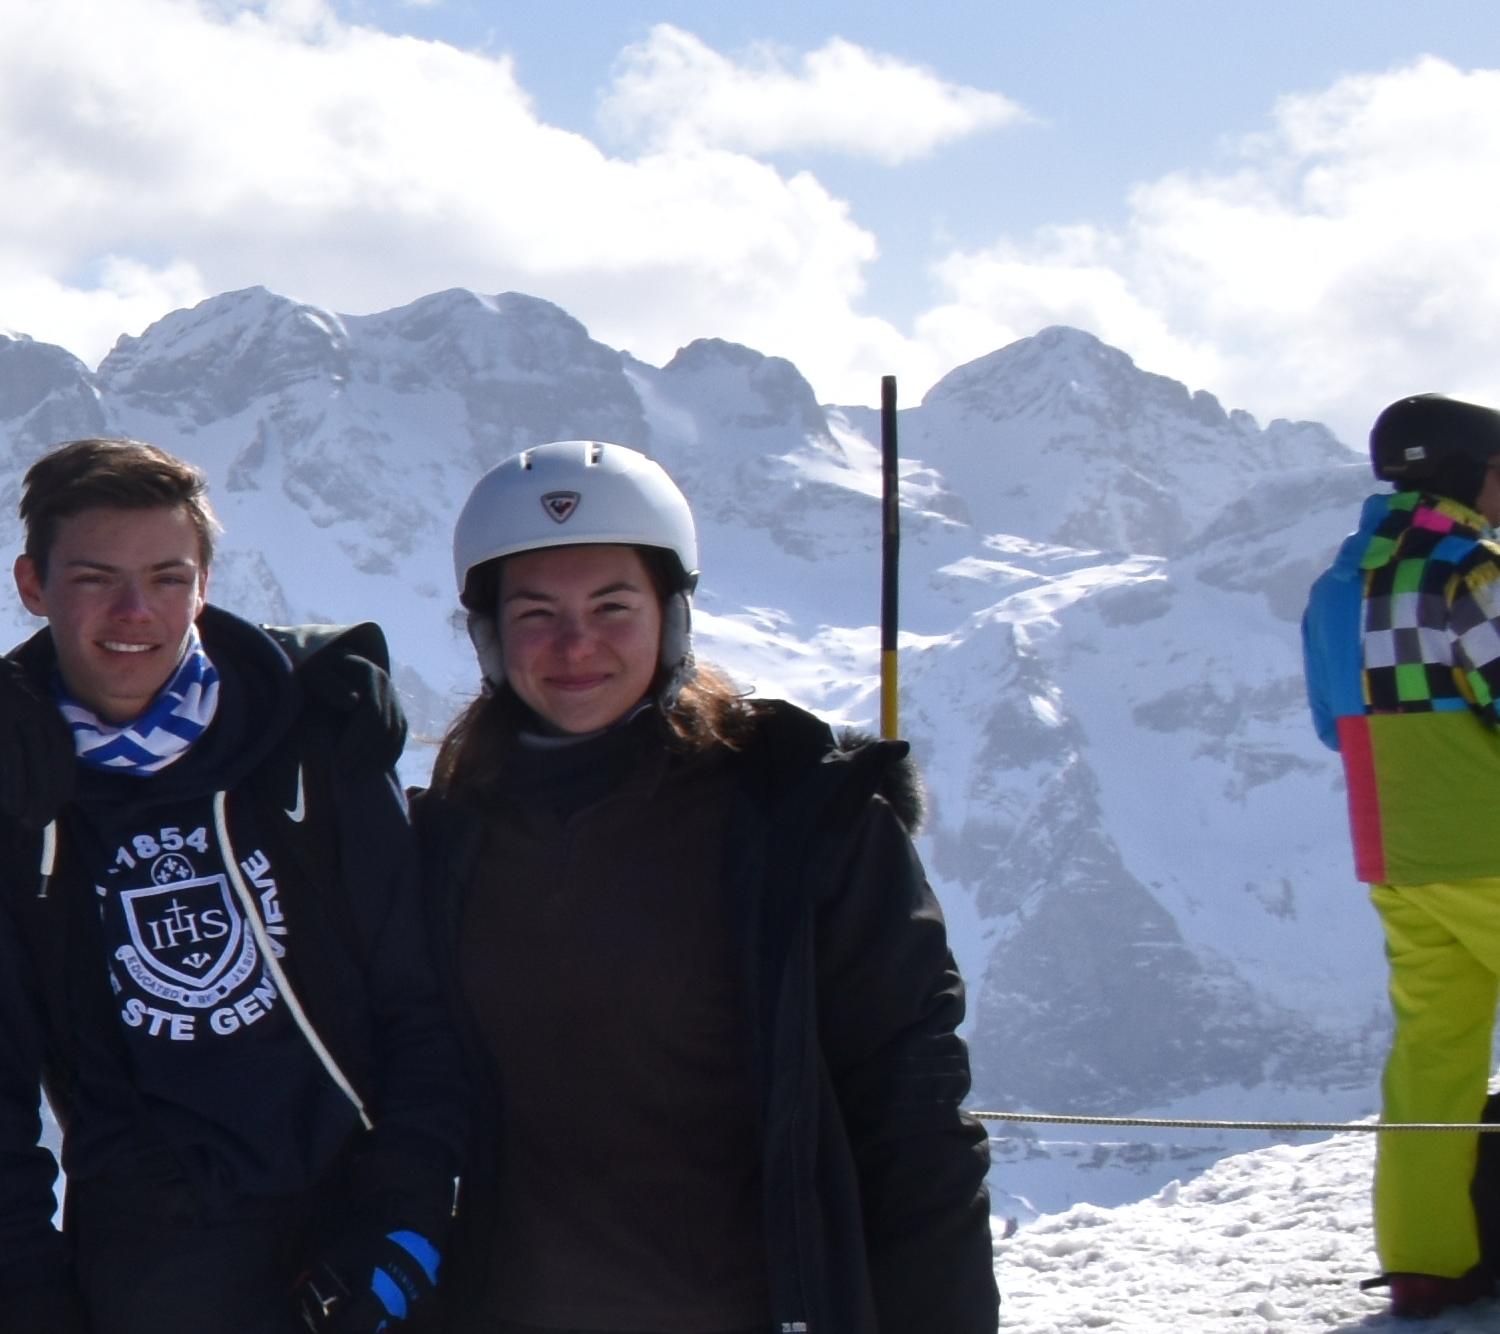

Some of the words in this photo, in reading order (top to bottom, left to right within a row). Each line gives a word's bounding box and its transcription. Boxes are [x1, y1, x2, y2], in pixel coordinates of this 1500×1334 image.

[115, 827, 209, 869] 1854
[147, 899, 229, 951] IHS
[121, 999, 195, 1041] STE
